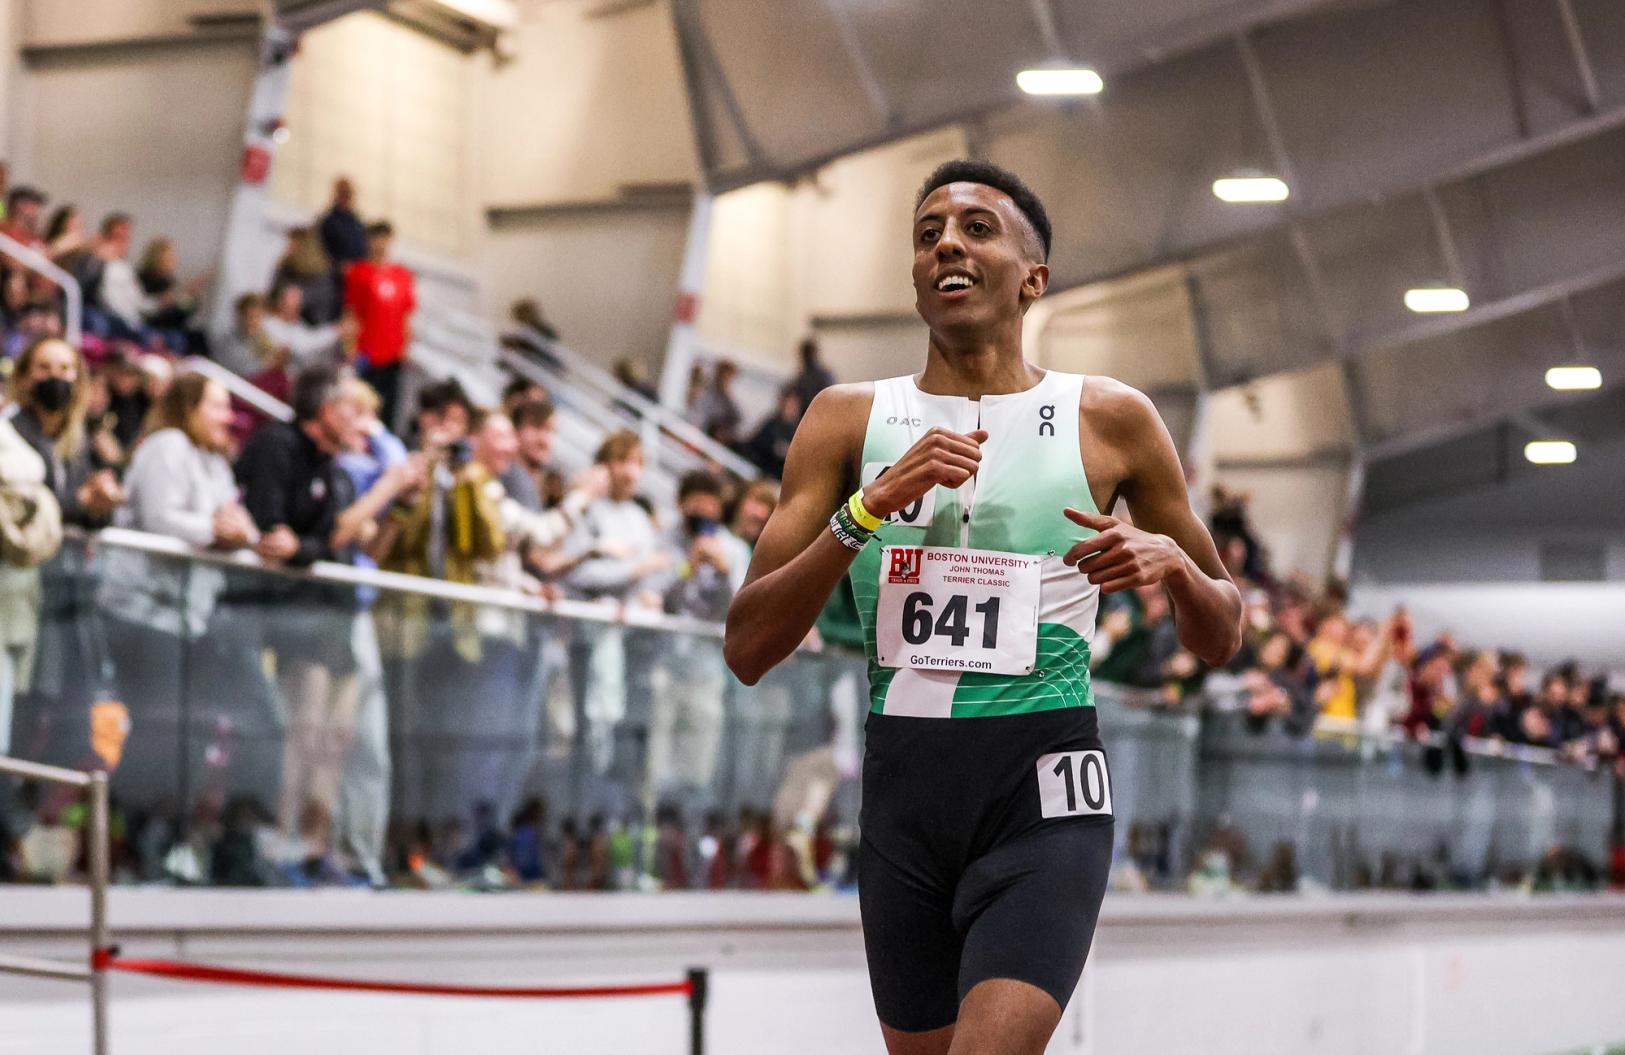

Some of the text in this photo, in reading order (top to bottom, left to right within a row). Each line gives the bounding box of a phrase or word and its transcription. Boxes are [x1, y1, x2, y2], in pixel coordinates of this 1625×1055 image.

[889, 549, 923, 577] BU
[927, 552, 1029, 568] BOSTON UNIVERSITY
[949, 565, 1005, 576] JOHN THOMAS
[943, 575, 1011, 587] TERRIER CLASSIC
[902, 592, 1000, 649] 641
[910, 655, 992, 669] GoTerriers.com
[1053, 753, 1105, 811] 10
